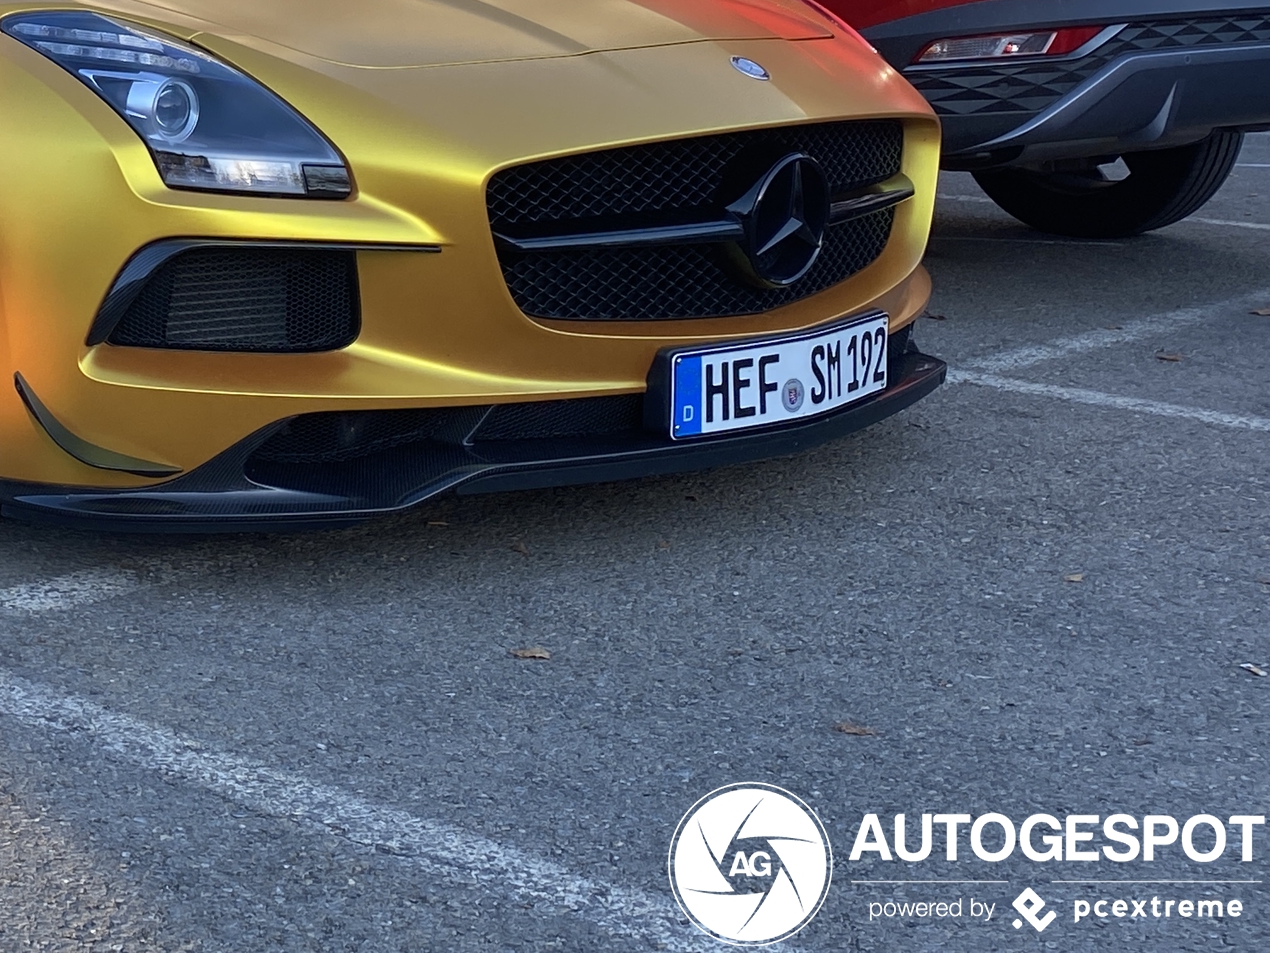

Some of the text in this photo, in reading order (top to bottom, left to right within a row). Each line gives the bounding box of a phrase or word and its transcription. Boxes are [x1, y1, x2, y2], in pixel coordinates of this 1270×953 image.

[705, 353, 780, 423] HEF
[810, 339, 841, 404] SM
[847, 326, 887, 393] 192
[683, 405, 693, 422] D
